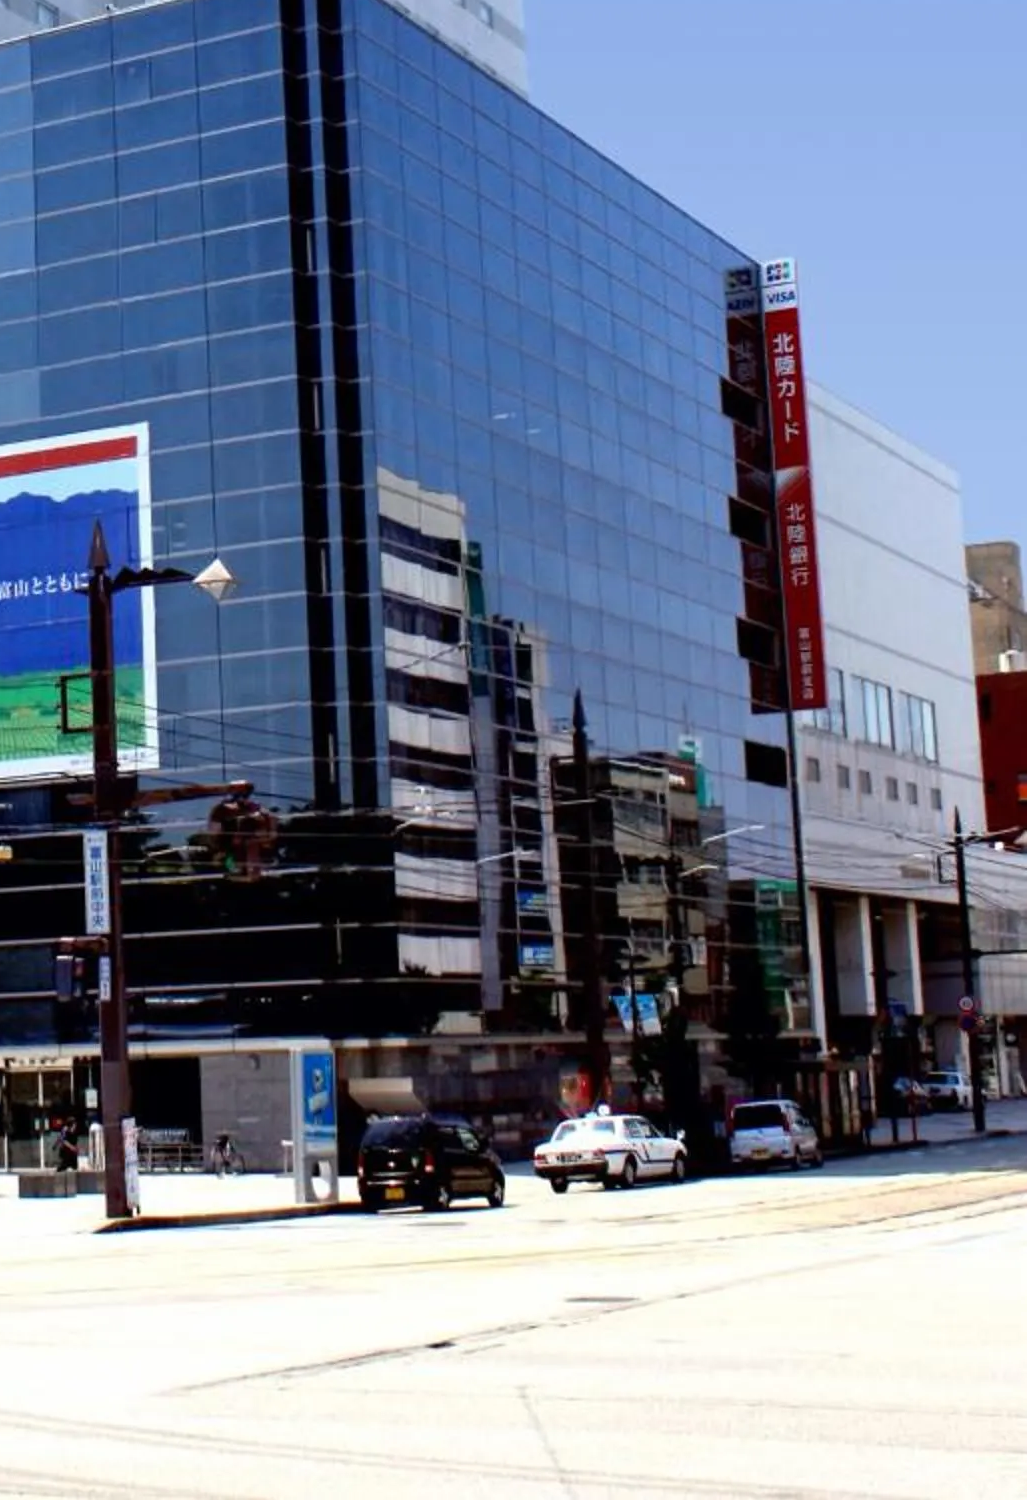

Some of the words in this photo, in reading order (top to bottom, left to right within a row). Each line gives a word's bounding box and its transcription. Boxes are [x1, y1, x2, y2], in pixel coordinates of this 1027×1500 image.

[766, 290, 796, 304] VISA
[773, 332, 800, 443] 北陸カード
[785, 503, 810, 587] 北陸銀行
